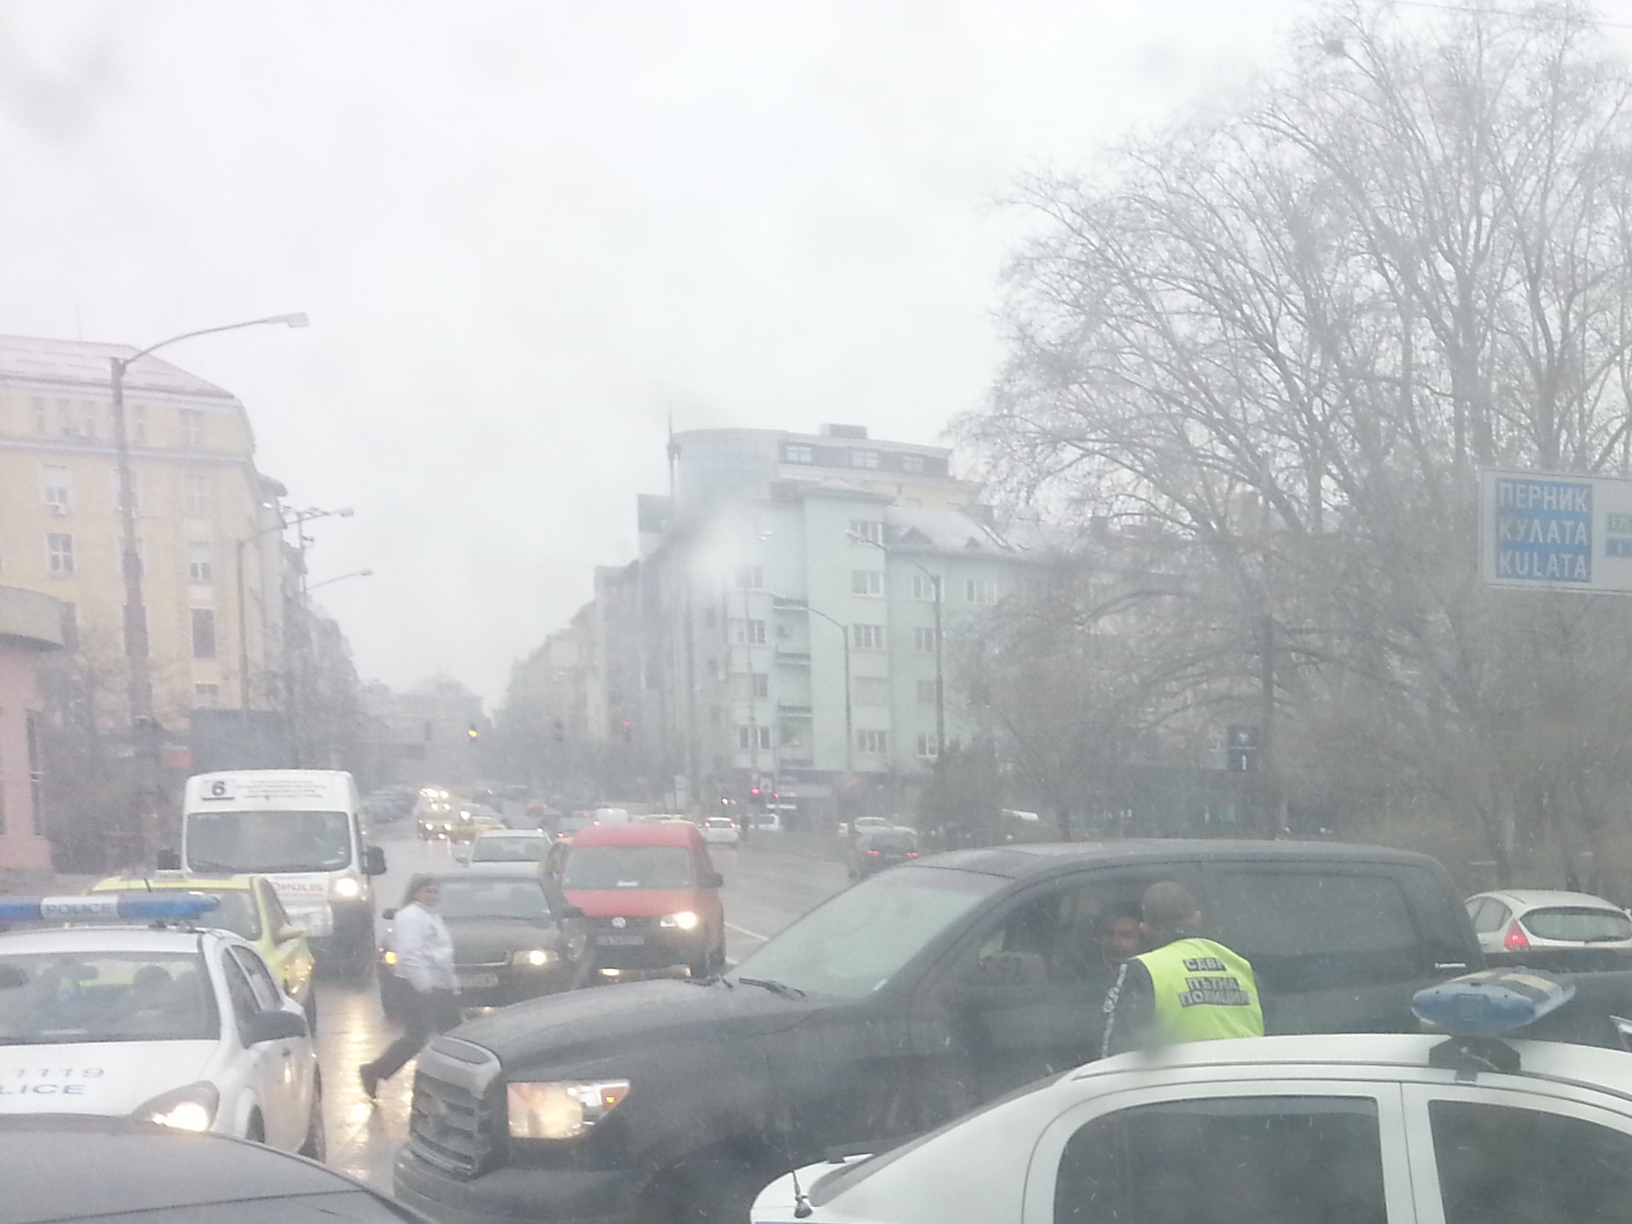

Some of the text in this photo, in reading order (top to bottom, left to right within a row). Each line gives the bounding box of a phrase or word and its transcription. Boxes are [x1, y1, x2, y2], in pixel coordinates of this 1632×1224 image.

[1500, 482, 1588, 512] ПЕРНИК
[1500, 516, 1590, 546] КУЛАТА
[1500, 550, 1588, 579] KULATA
[212, 780, 226, 796] 6
[46, 903, 113, 916] POLICE
